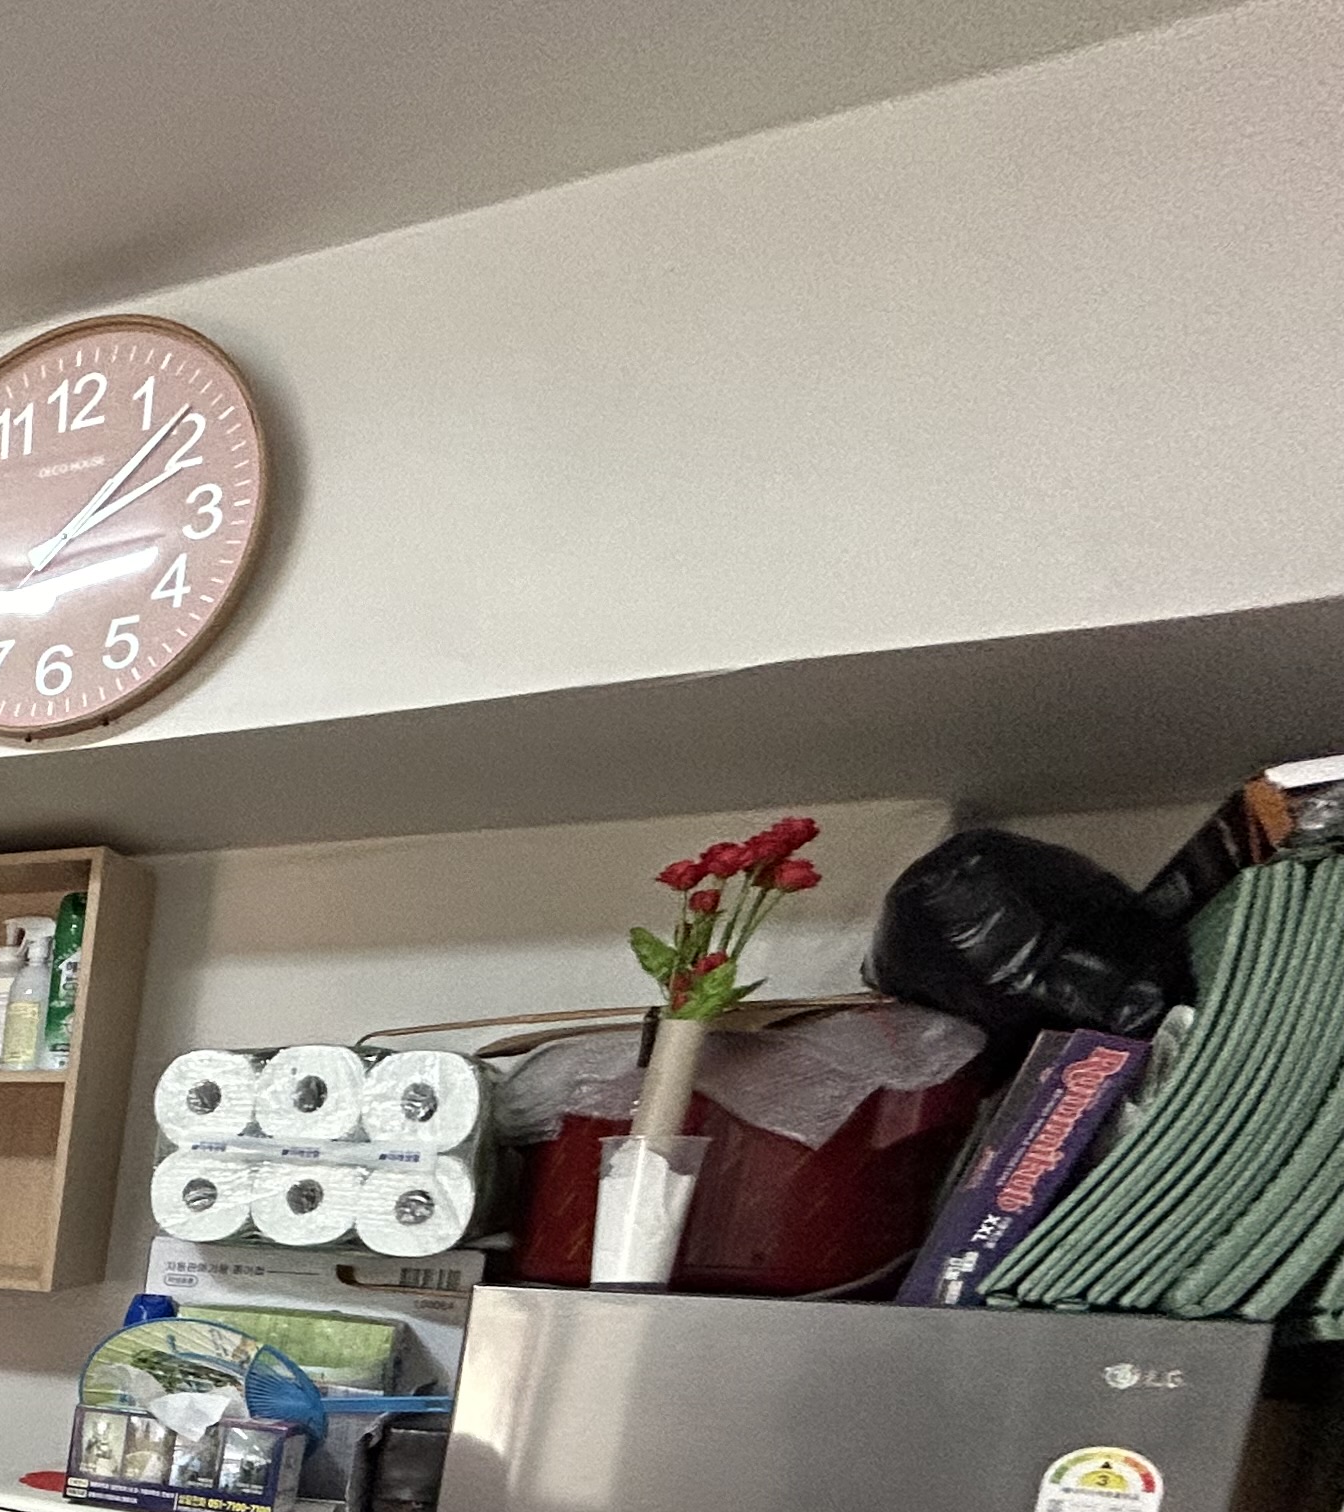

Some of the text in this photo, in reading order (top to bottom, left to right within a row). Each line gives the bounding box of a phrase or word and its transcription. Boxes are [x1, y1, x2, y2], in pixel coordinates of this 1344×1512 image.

[48, 371, 108, 434] 12
[131, 375, 156, 431] 1
[164, 412, 206, 472] 2
[182, 483, 223, 540] 3
[151, 553, 191, 609] 4
[35, 644, 74, 696] 6
[101, 614, 141, 670] 5
[1095, 1474, 1110, 1488] 3
